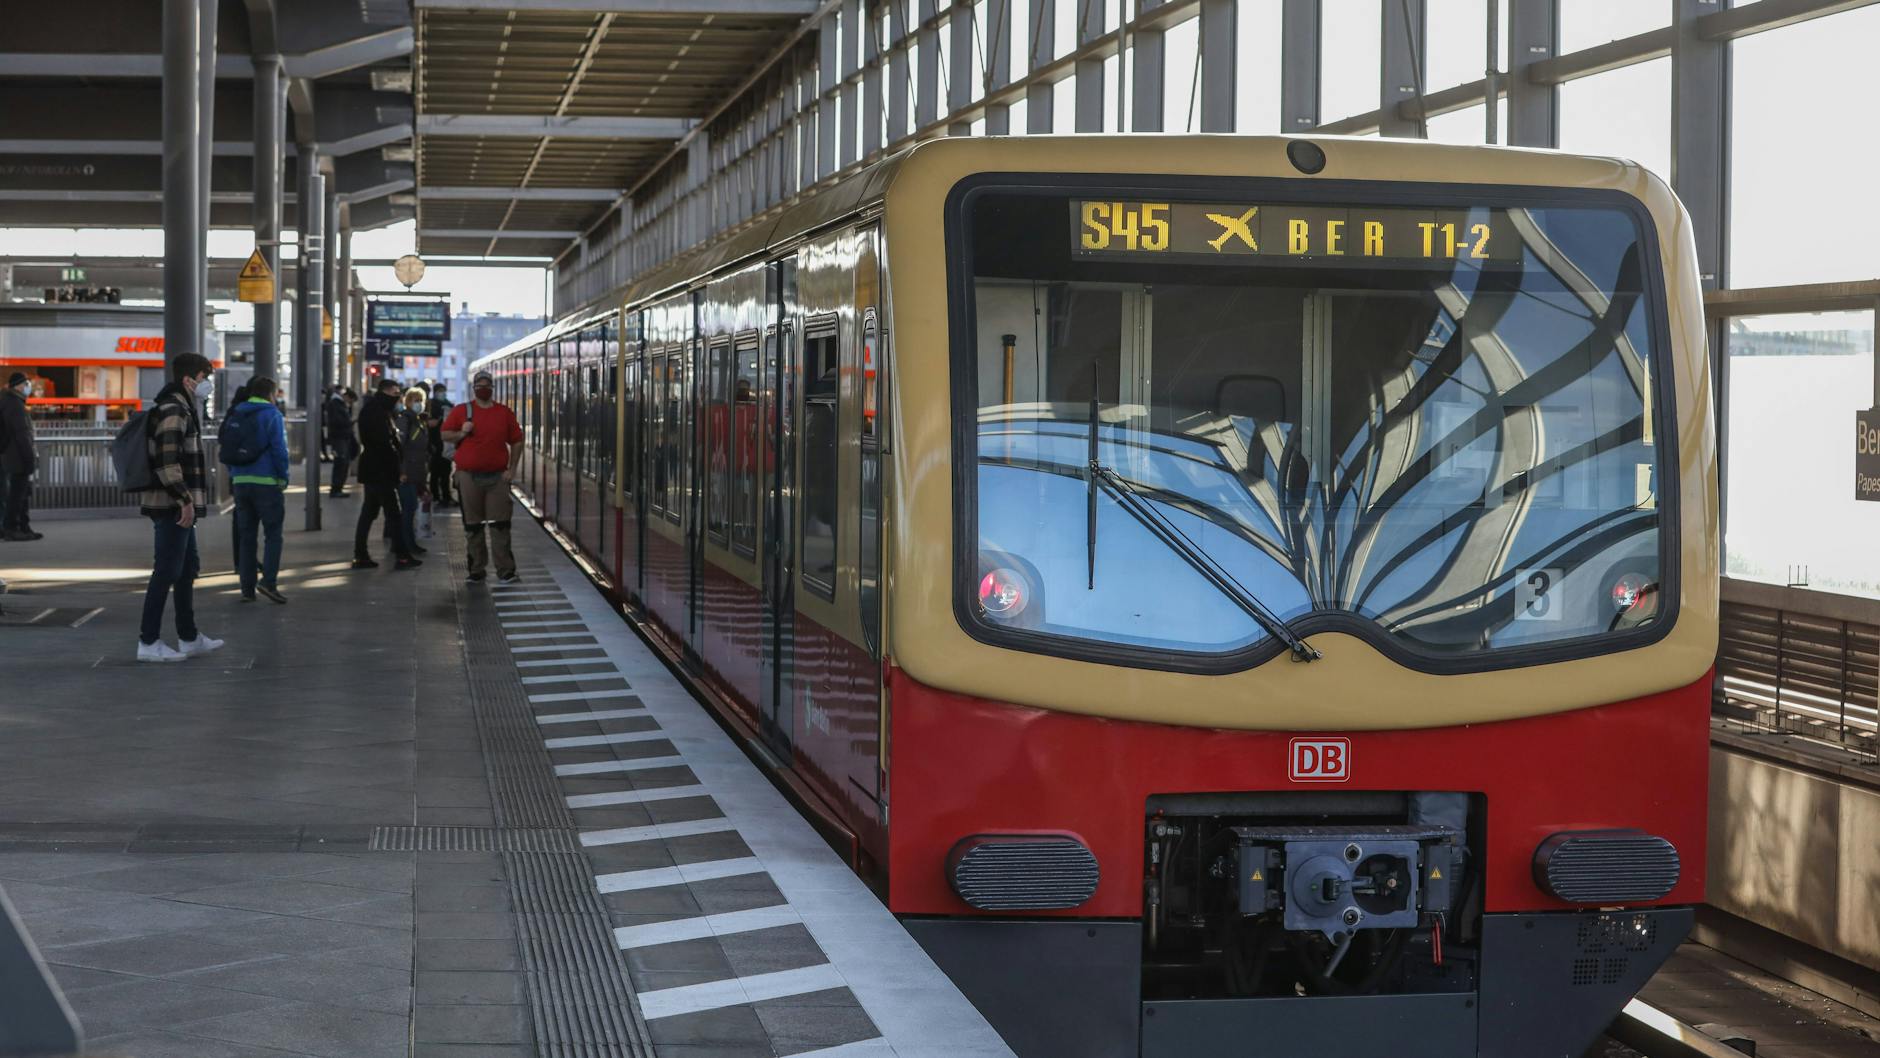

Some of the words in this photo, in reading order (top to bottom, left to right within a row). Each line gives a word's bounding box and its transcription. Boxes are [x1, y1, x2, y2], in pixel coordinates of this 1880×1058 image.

[1081, 202, 1169, 251] S45
[1418, 222, 1490, 259] T1-2
[375, 343, 390, 355] 12
[1526, 570, 1551, 618] 3
[1297, 745, 1343, 774] DB
